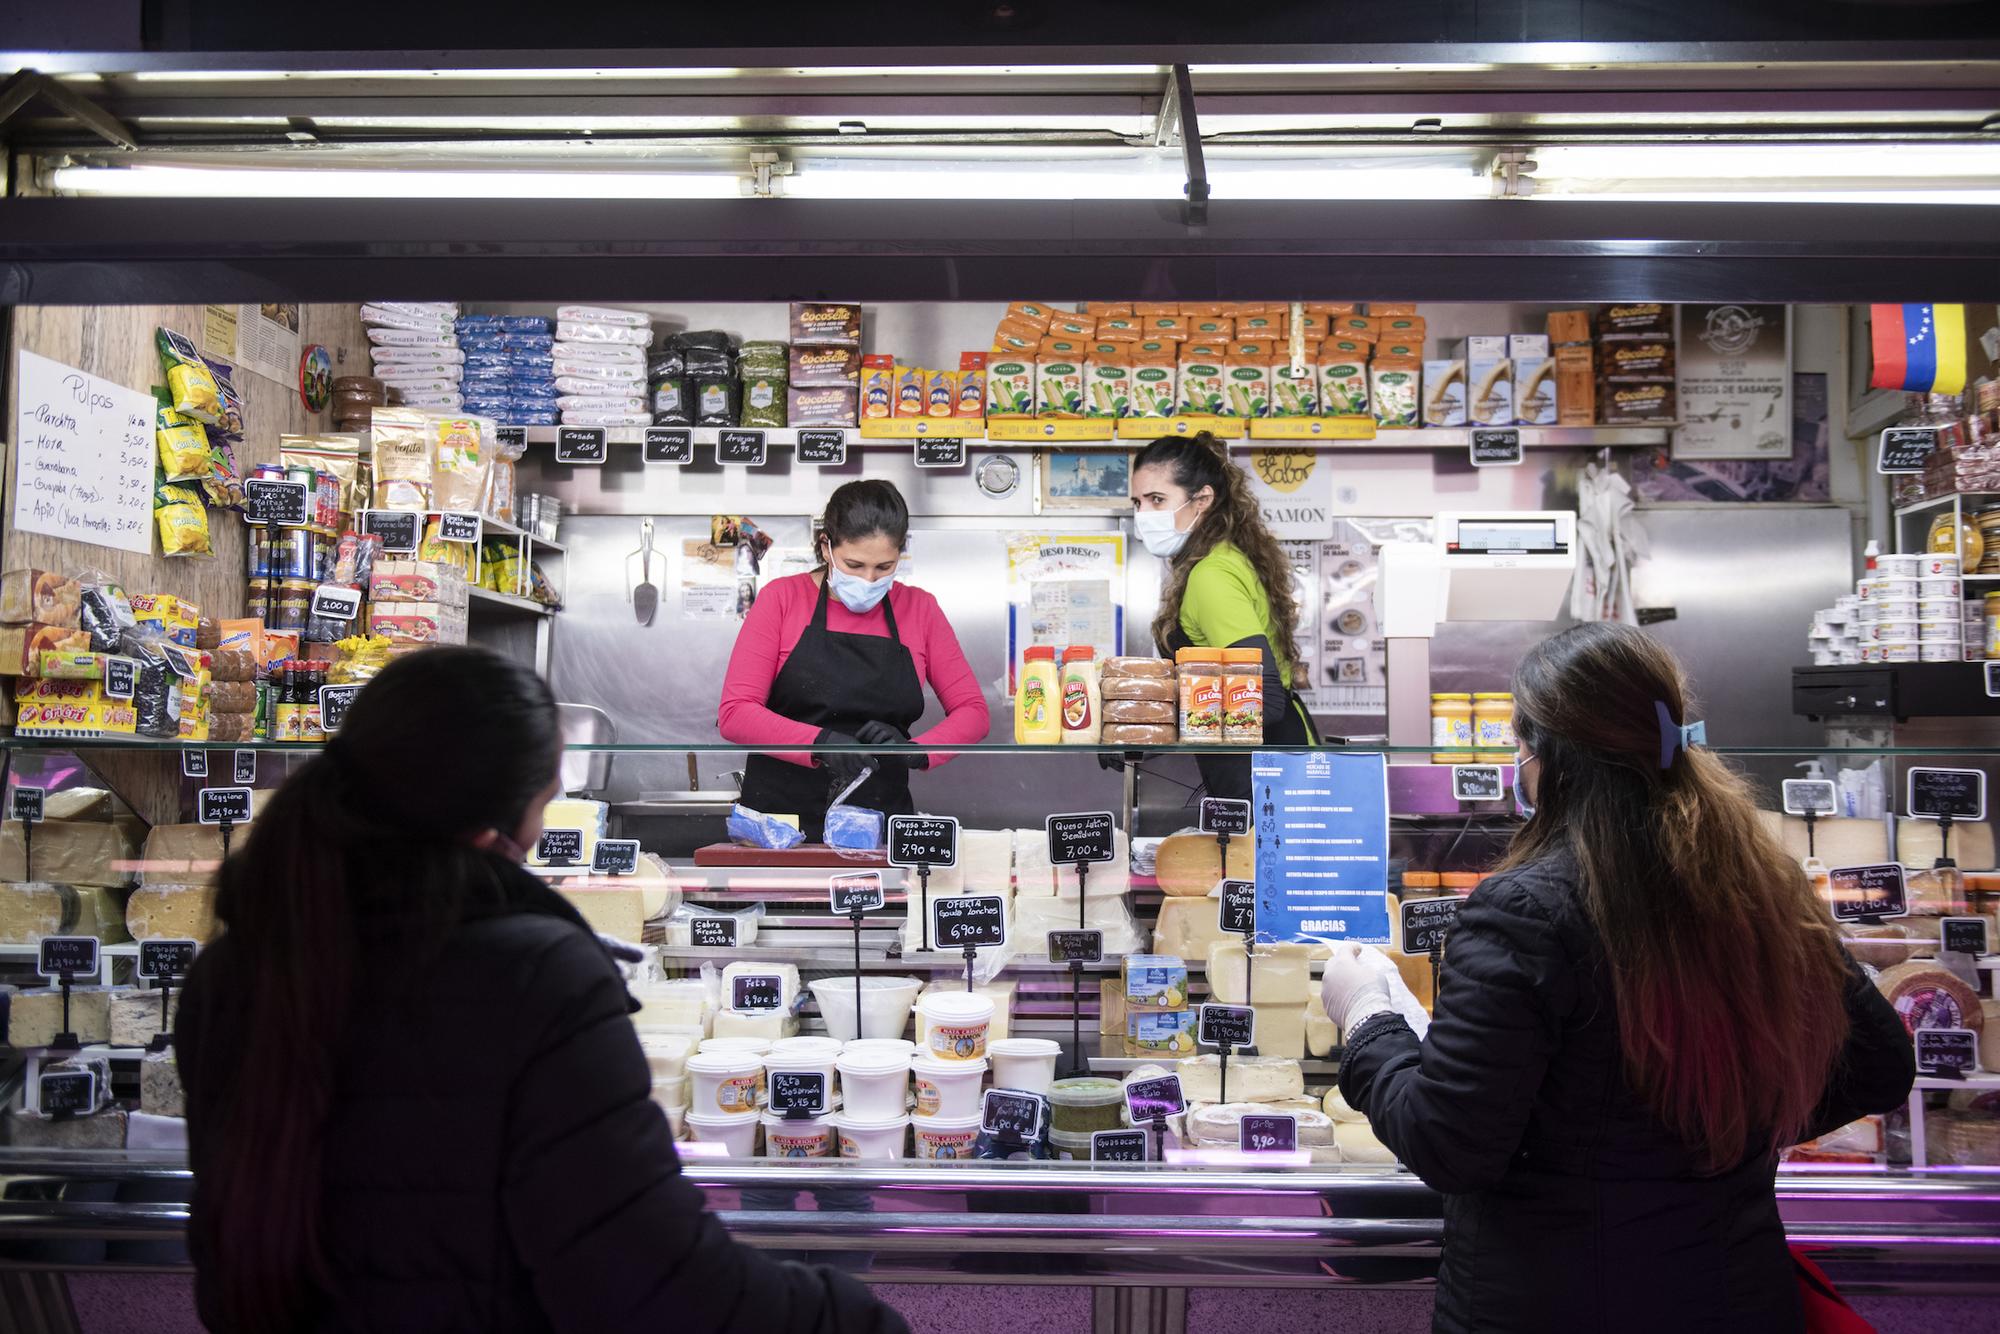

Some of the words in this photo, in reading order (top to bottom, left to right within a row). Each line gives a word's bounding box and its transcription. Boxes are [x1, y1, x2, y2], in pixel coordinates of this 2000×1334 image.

[1040, 545, 1064, 558] UESO
[1066, 546, 1102, 559] FRESCO
[895, 821, 919, 830] Queso
[922, 820, 946, 829] Duro
[1056, 821, 1083, 831] Queso
[1061, 830, 1101, 841] Semiduro
[901, 844, 926, 857] 7,90
[1066, 845, 1091, 859] 7,00
[1834, 873, 1858, 882] Queso
[946, 901, 982, 910] OFERTA
[1844, 899, 1880, 913] 10,90
[1300, 920, 1346, 932] GRACIAS
[702, 935, 727, 944] 10,90
[745, 979, 766, 988] Feta
[744, 995, 763, 1006] 8,90
[962, 1025, 987, 1034] CRIOLLA
[777, 1076, 800, 1089] Nata
[787, 1098, 809, 1107] 3,45
